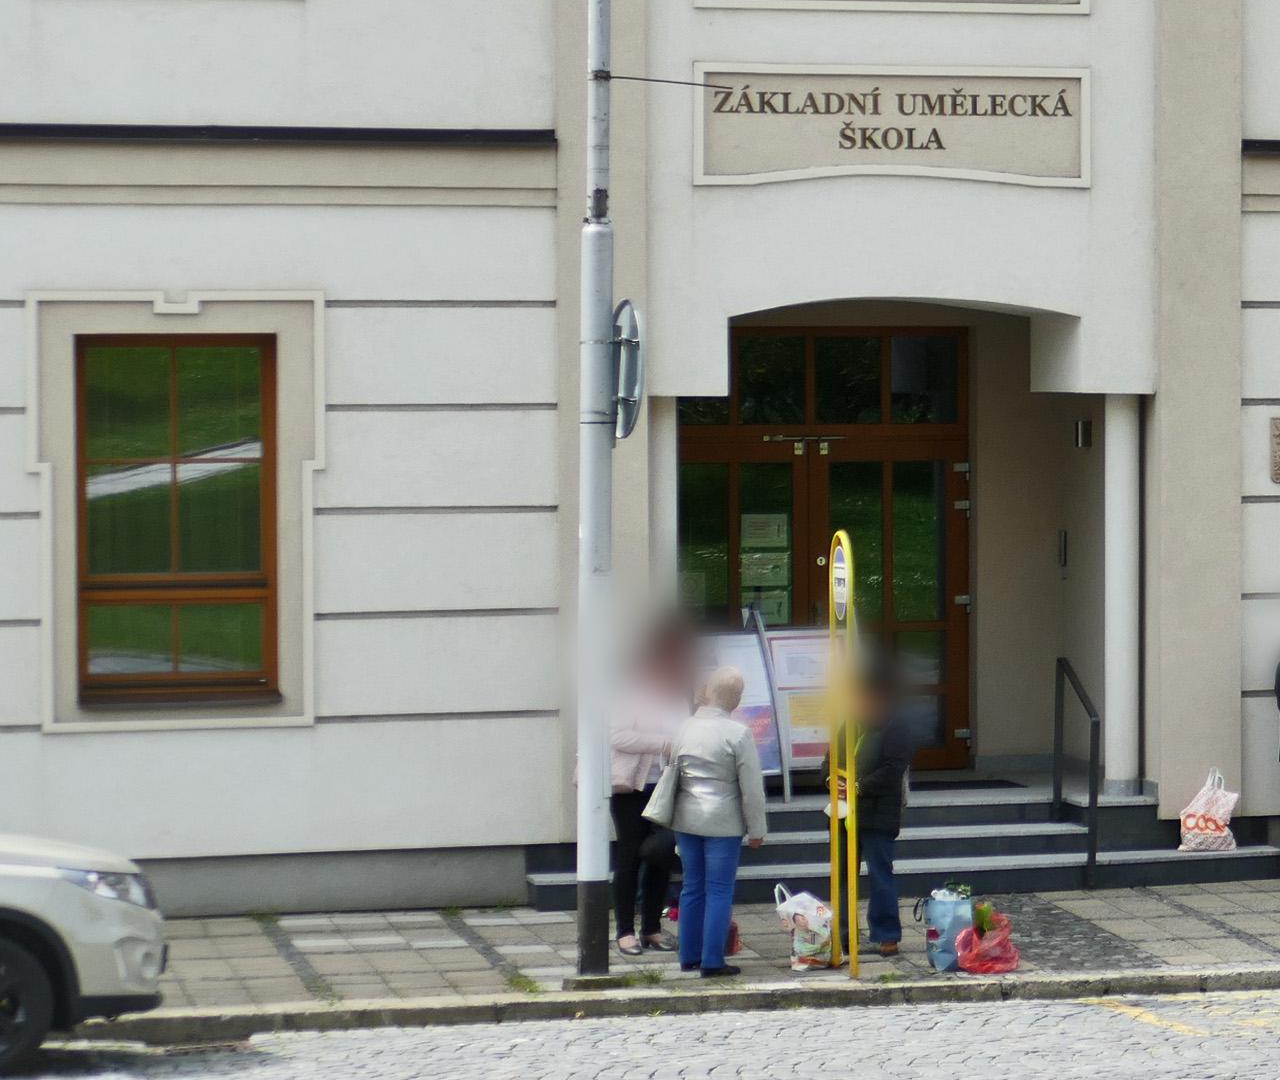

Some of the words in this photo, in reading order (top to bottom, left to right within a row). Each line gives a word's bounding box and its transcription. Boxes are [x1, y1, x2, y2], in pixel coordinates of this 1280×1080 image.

[713, 85, 882, 115] ZÁKLADNÍ
[896, 88, 1073, 117] UMĚLECKÁ
[838, 121, 946, 151] ŠKOLA
